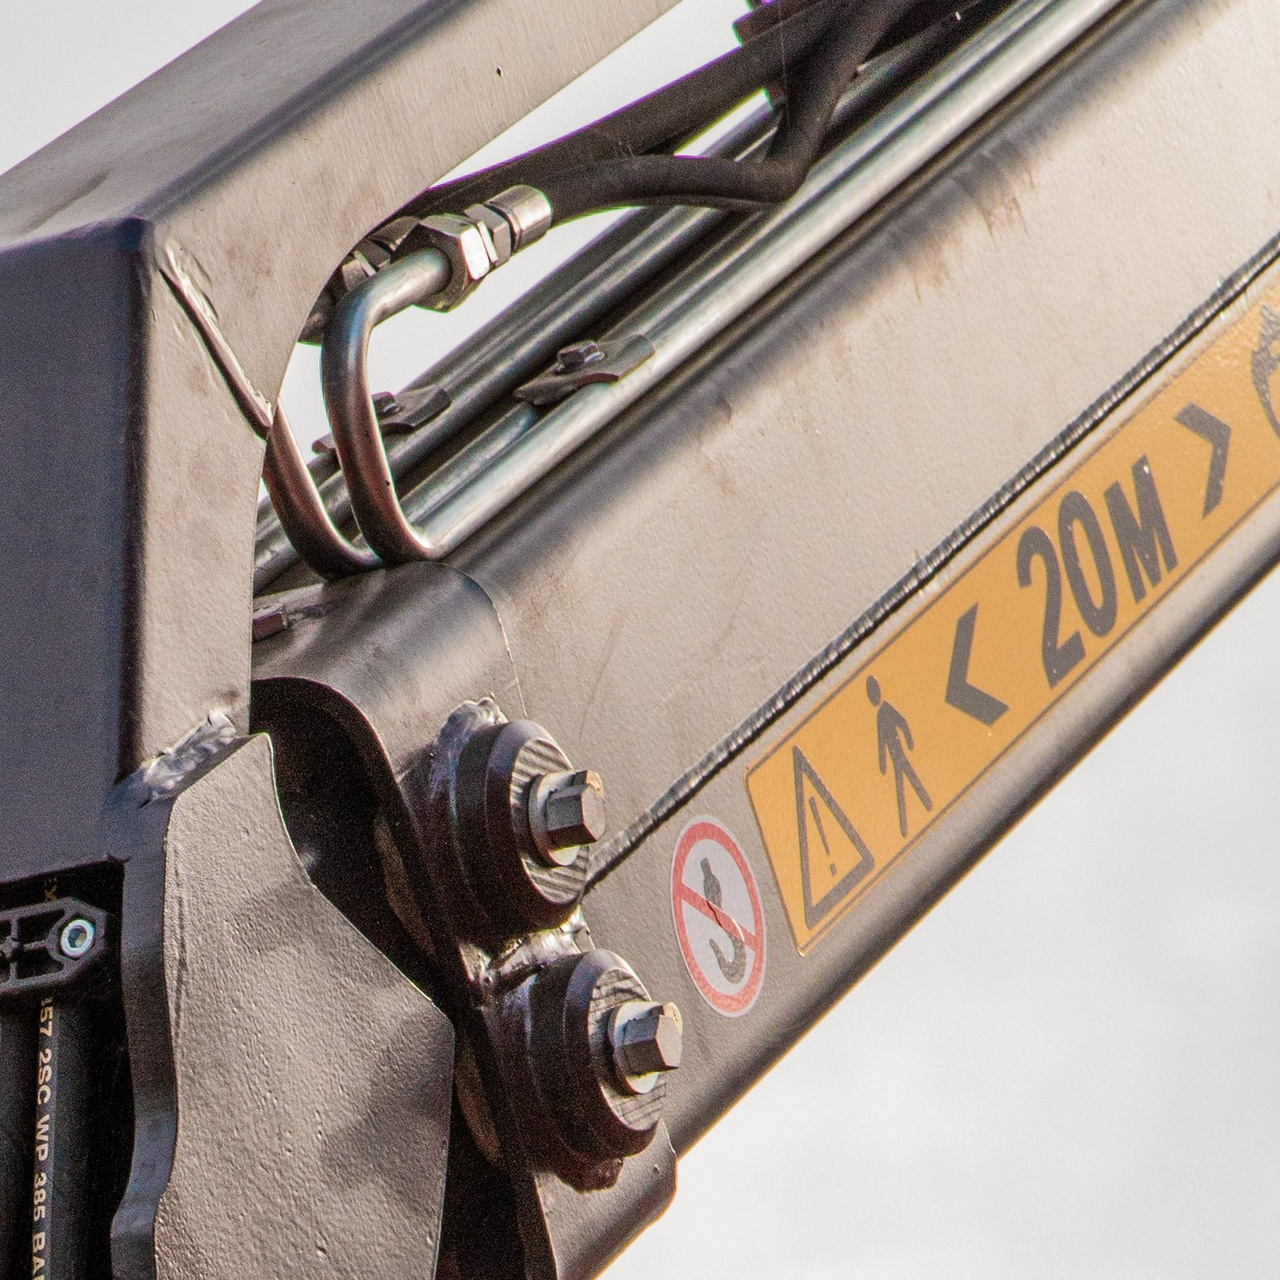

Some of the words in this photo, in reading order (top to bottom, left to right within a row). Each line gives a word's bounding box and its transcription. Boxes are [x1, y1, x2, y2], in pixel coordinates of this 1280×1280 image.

[37, 1048, 53, 1106] 2SC
[35, 1114, 50, 1161] WP
[33, 1170, 47, 1220] 385
